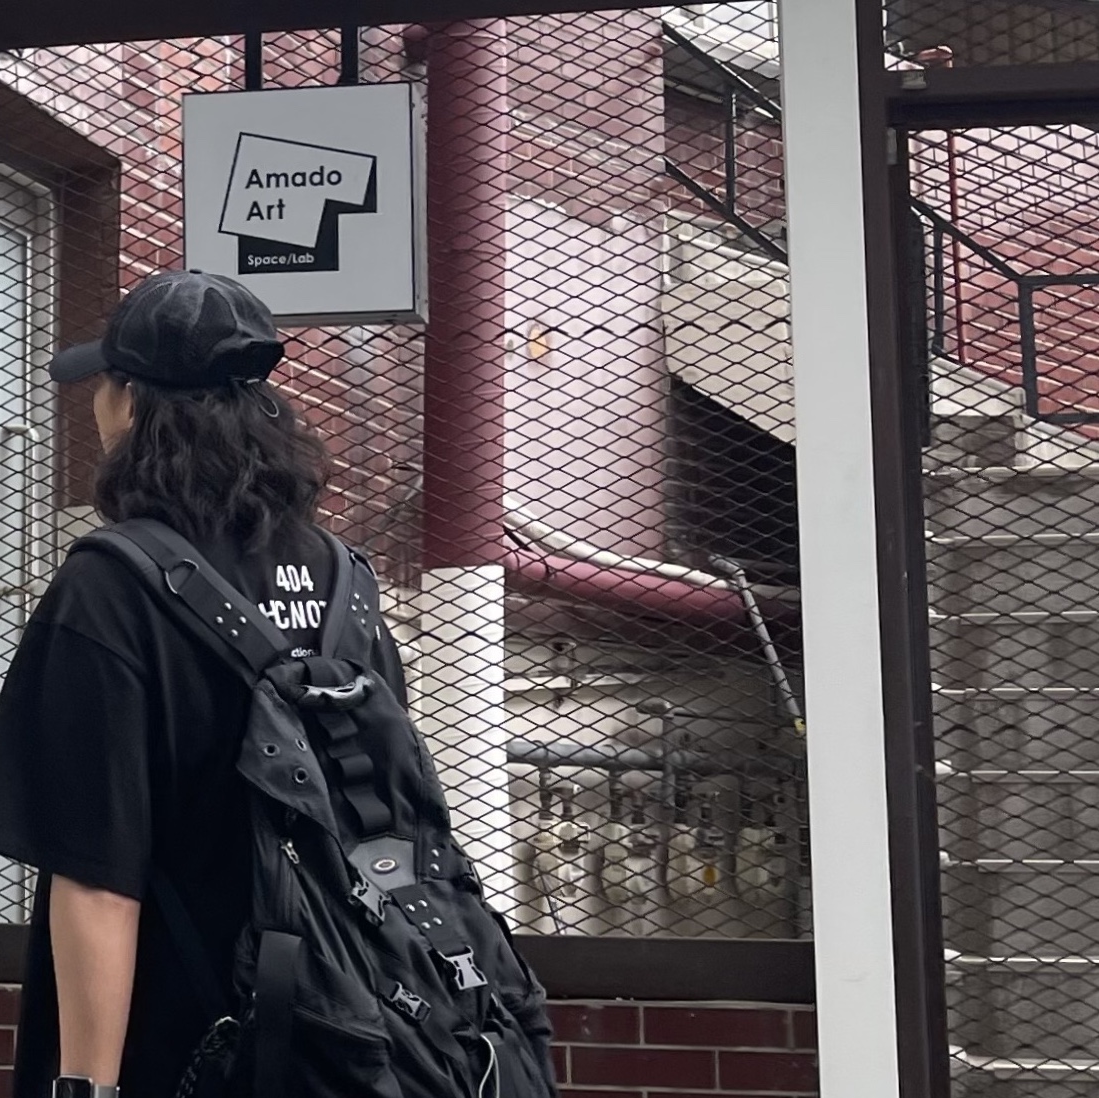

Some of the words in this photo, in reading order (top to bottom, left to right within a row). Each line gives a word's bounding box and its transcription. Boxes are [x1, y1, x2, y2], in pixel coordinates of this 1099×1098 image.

[245, 165, 342, 189] Amado
[246, 199, 286, 221] Art
[247, 253, 314, 268] Space/Lab
[275, 564, 315, 593] 404
